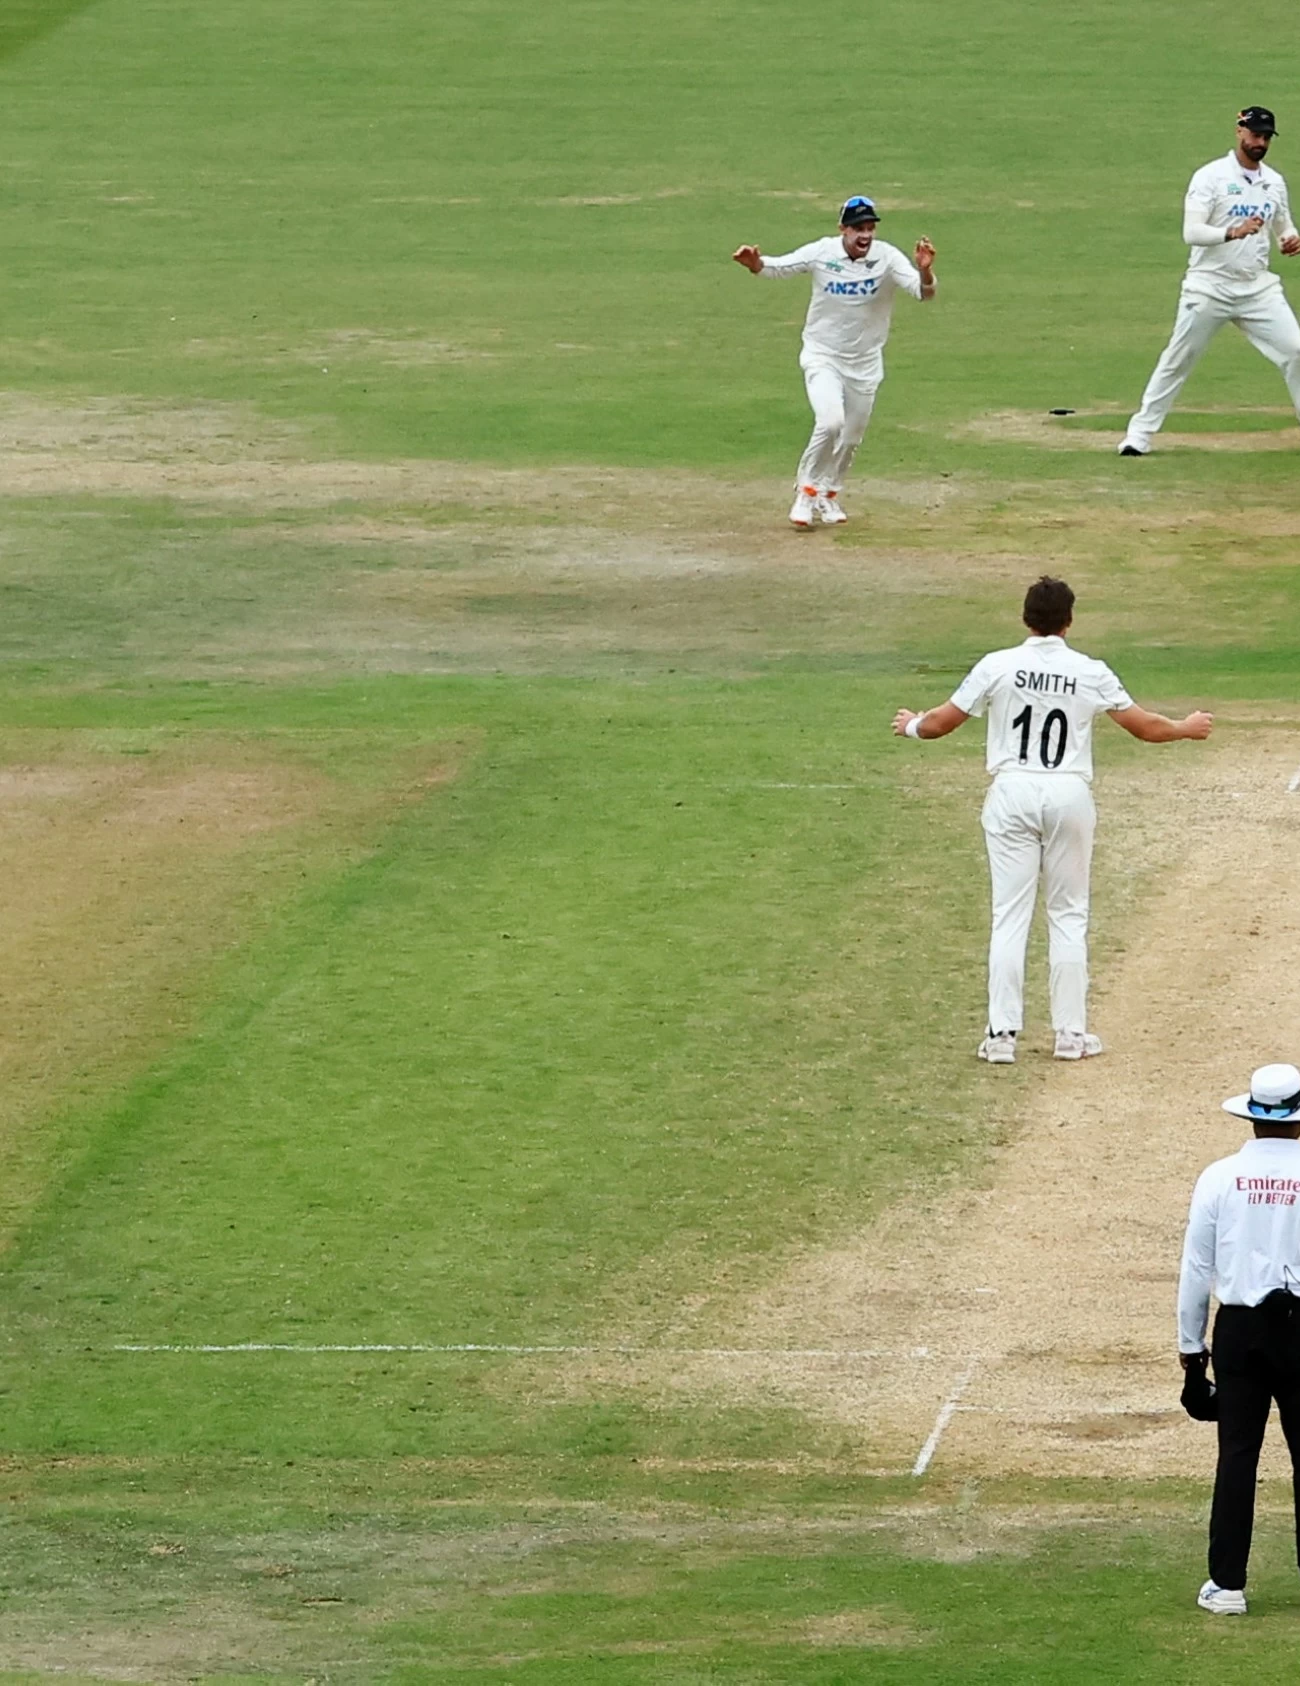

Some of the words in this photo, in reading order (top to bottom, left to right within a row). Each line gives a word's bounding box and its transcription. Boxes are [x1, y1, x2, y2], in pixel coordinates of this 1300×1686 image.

[1228, 204, 1259, 217] ANZ
[824, 281, 859, 295] ANZ
[1014, 669, 1077, 695] SMITH
[1012, 705, 1068, 769] 10
[1248, 1192, 1263, 1205] FLY
[1265, 1192, 1297, 1206] BETTER
